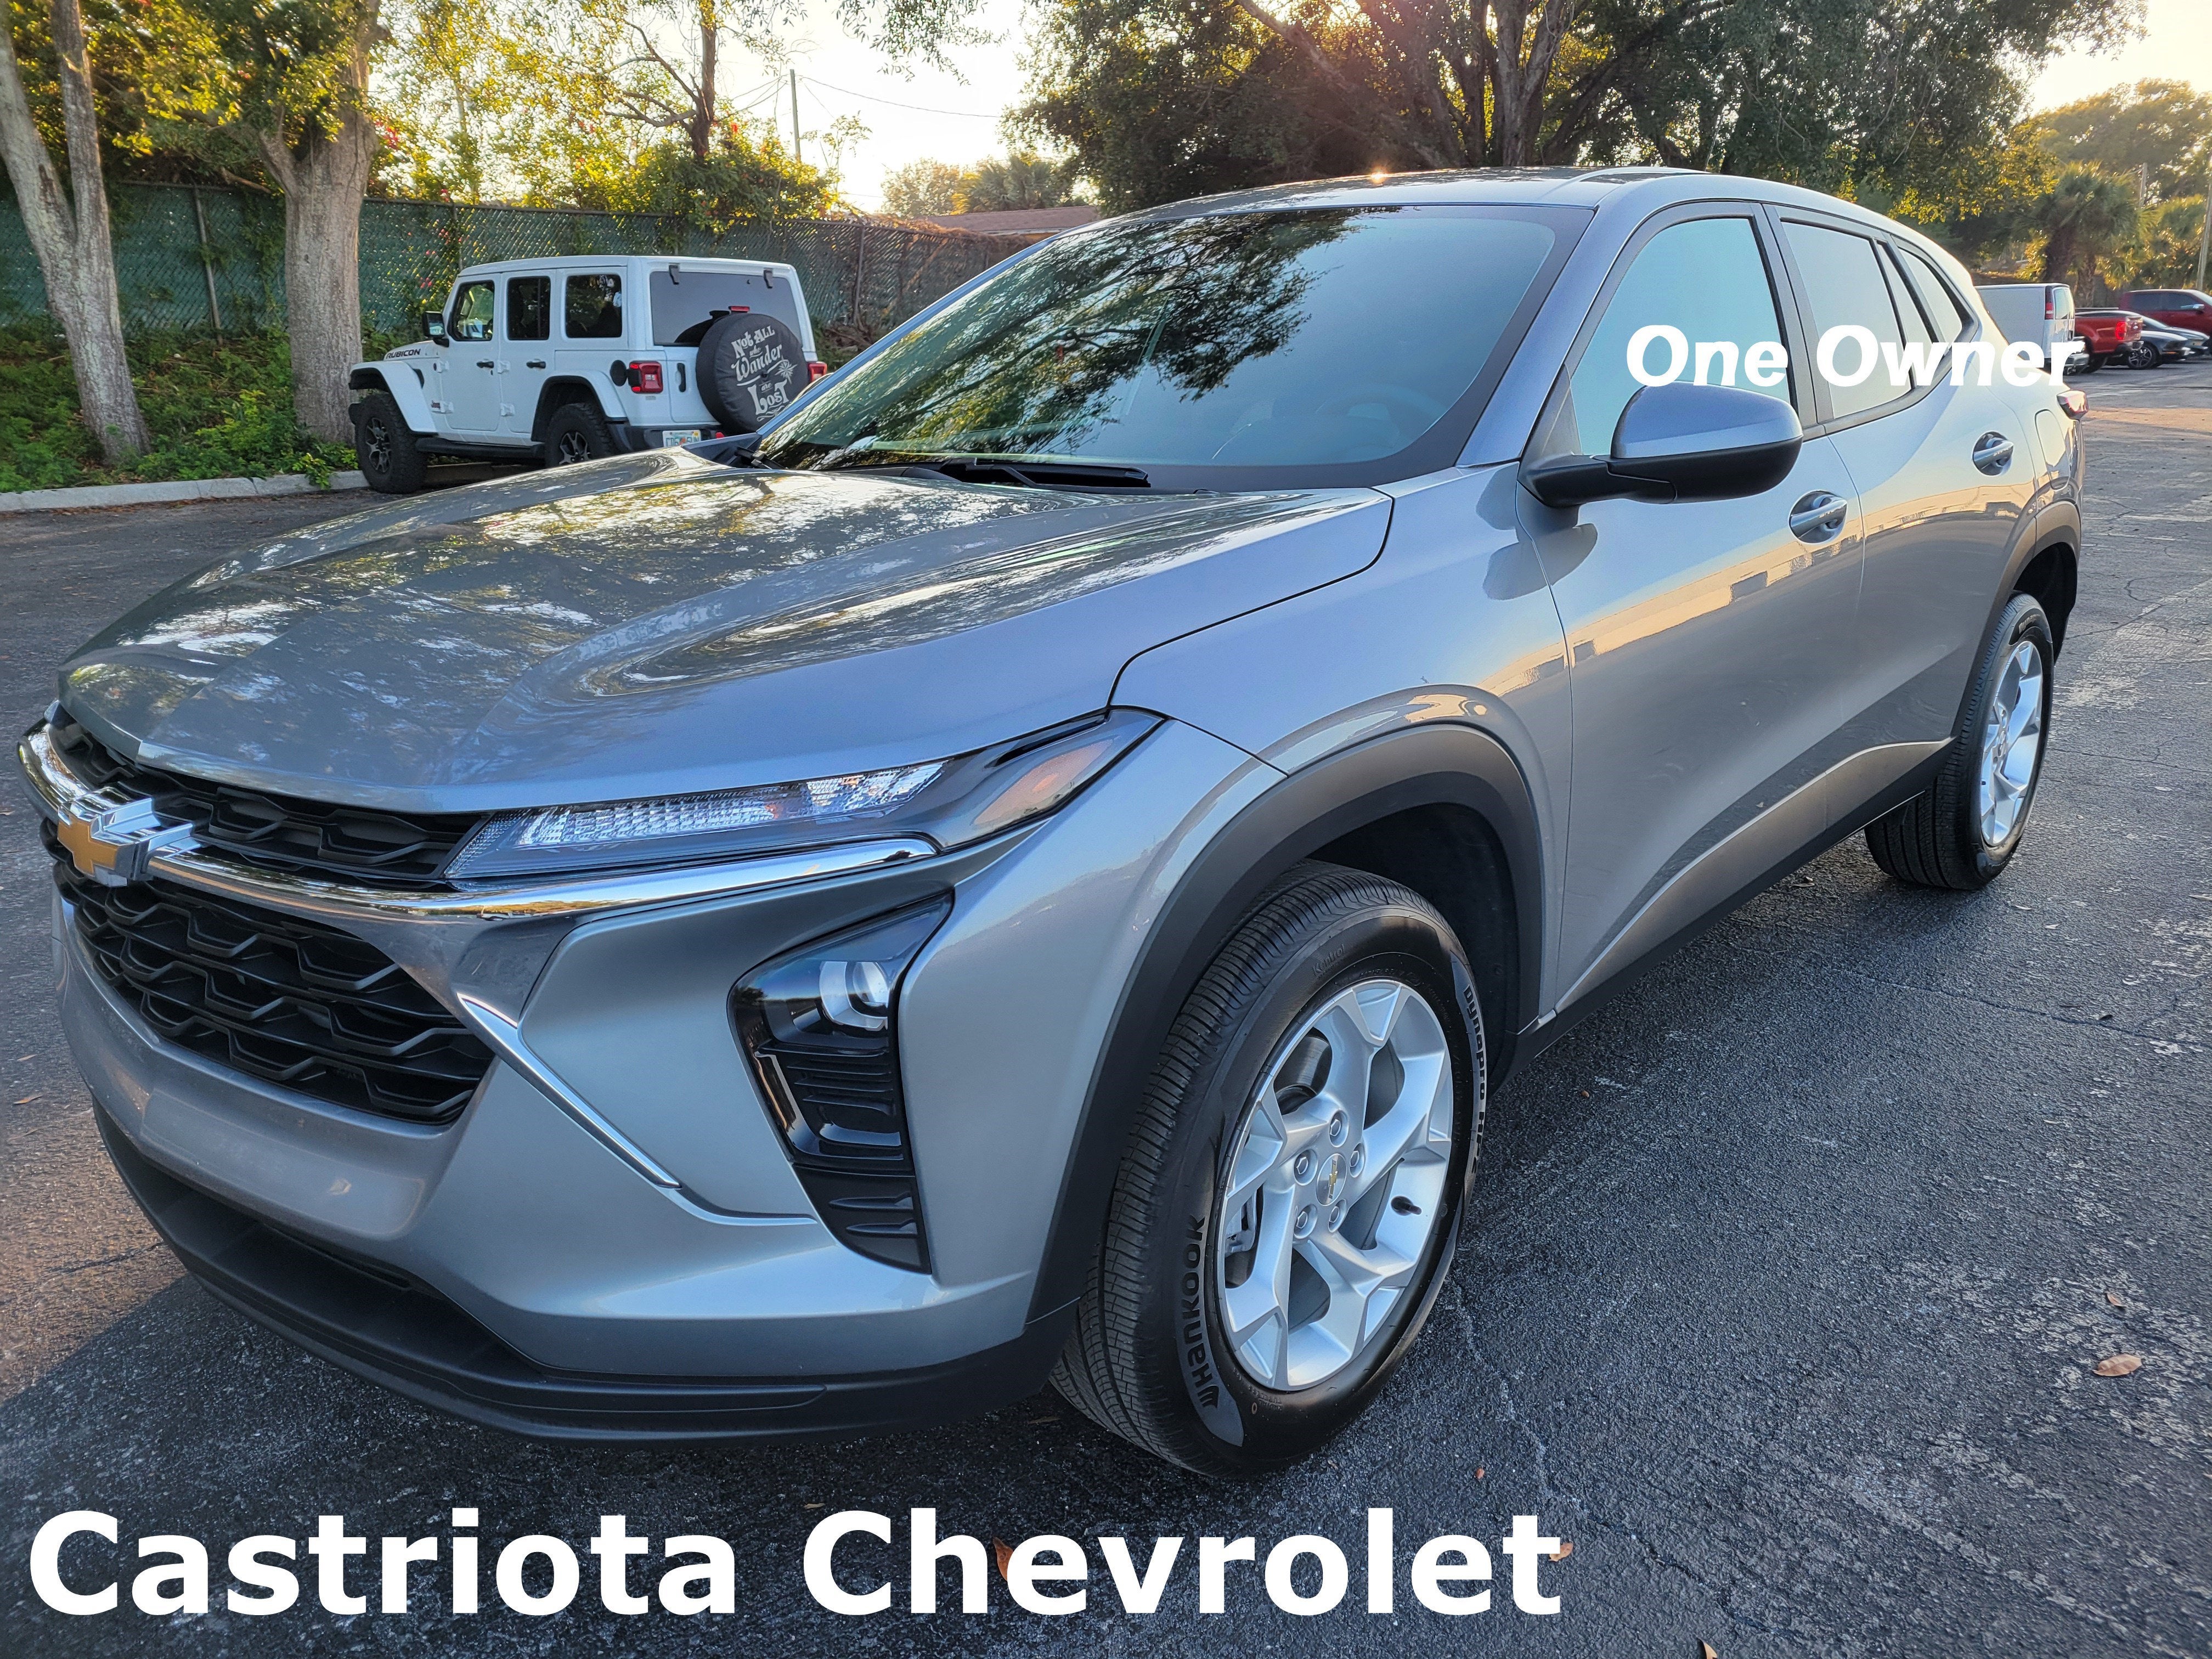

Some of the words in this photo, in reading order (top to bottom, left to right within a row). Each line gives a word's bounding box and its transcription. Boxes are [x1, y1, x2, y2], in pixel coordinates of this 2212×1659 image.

[386, 348, 421, 359] RUBICON
[731, 331, 754, 359] Not
[731, 344, 782, 381] Wander
